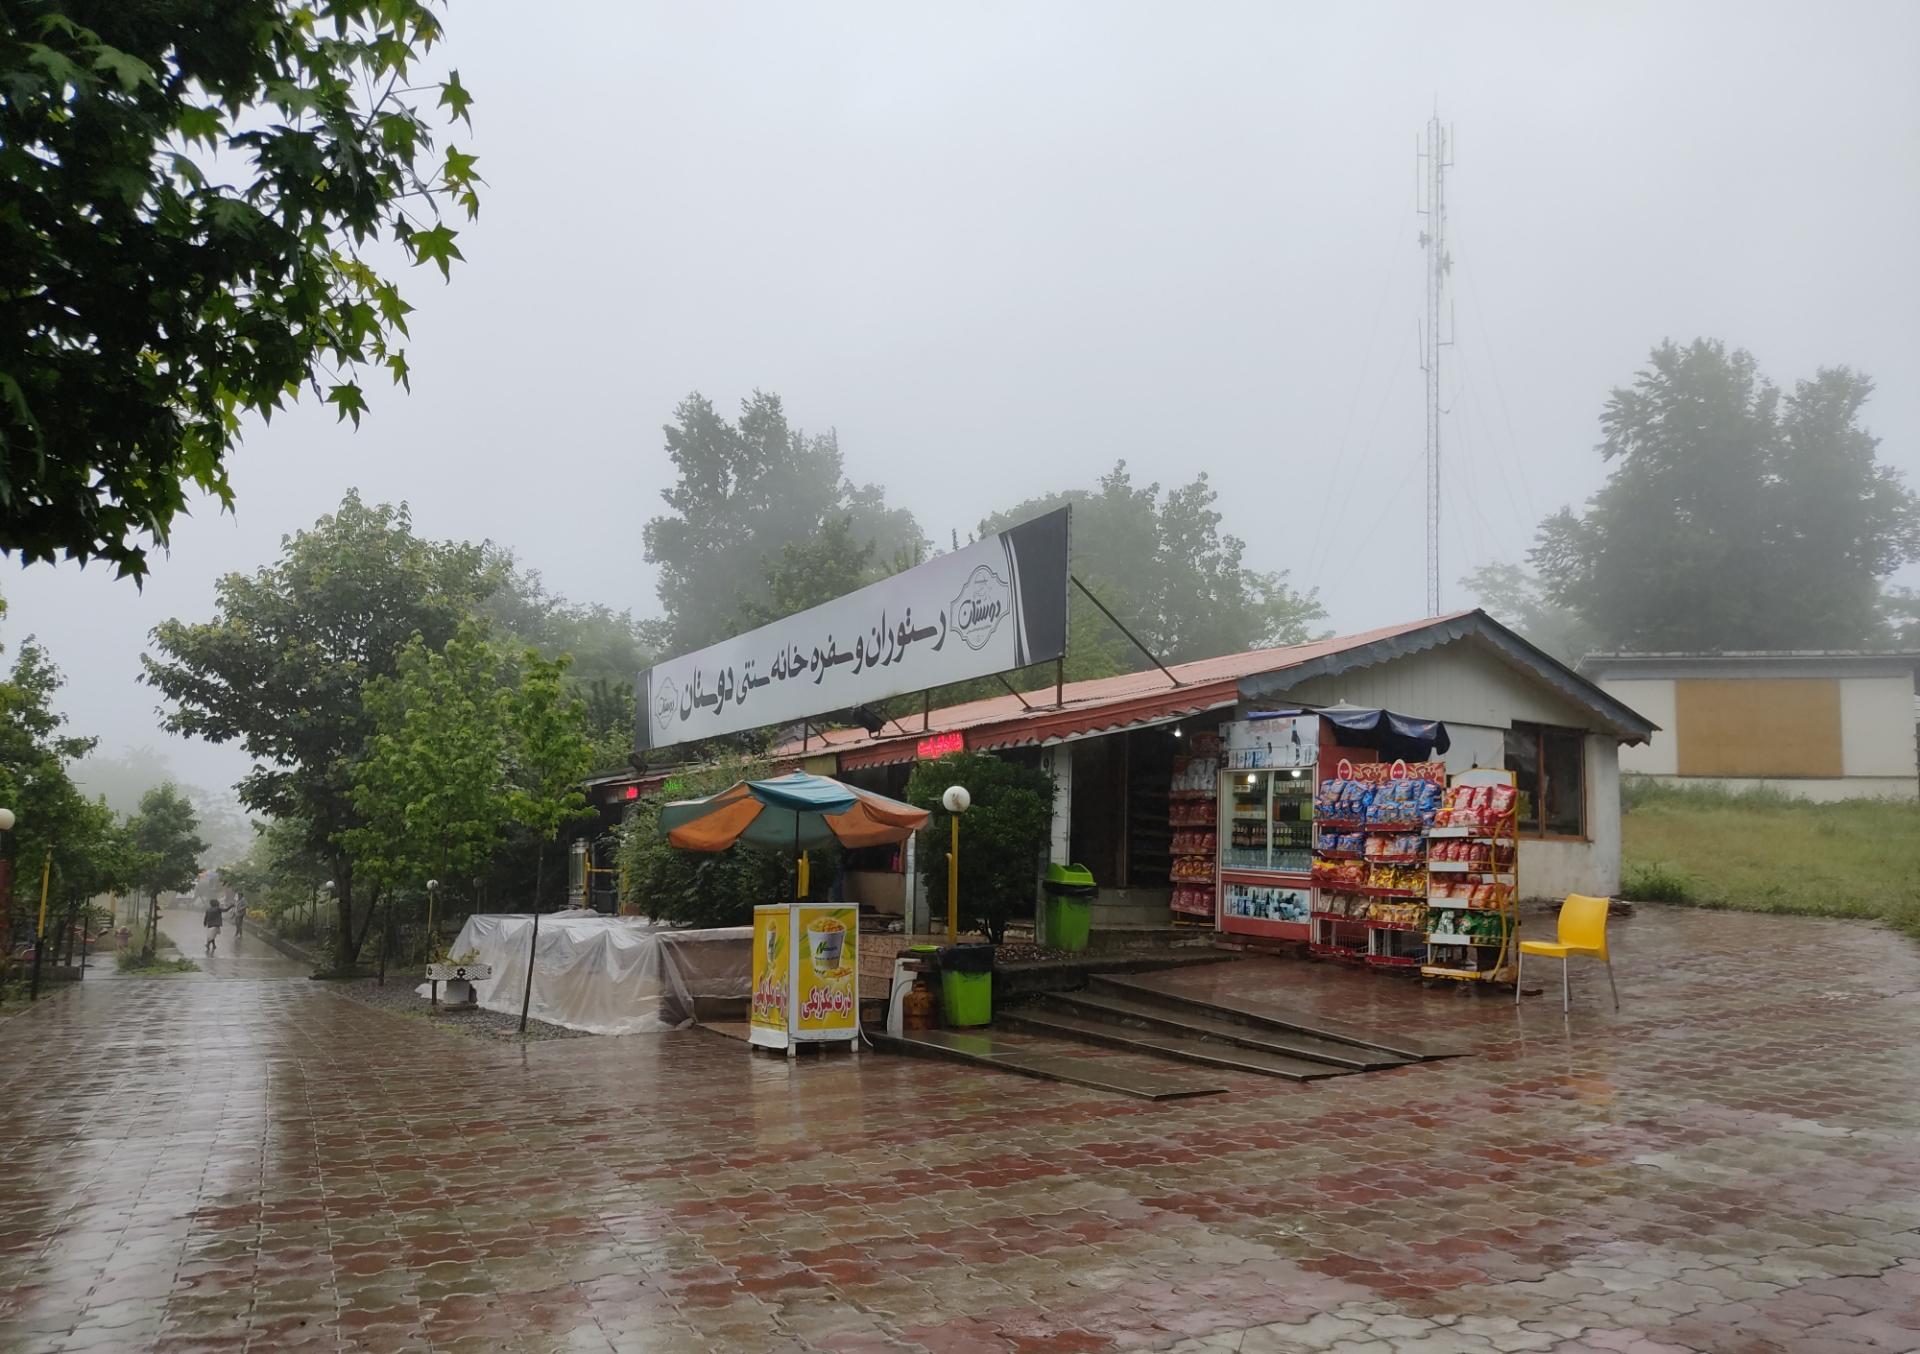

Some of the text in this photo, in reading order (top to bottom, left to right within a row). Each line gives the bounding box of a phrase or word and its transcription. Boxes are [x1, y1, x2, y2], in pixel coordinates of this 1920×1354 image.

[958, 599, 1001, 630] دوستان
[680, 607, 947, 722] رستوران و سفره خانه سنتی دوستان
[801, 983, 854, 1020] ذرت مکزیکی
